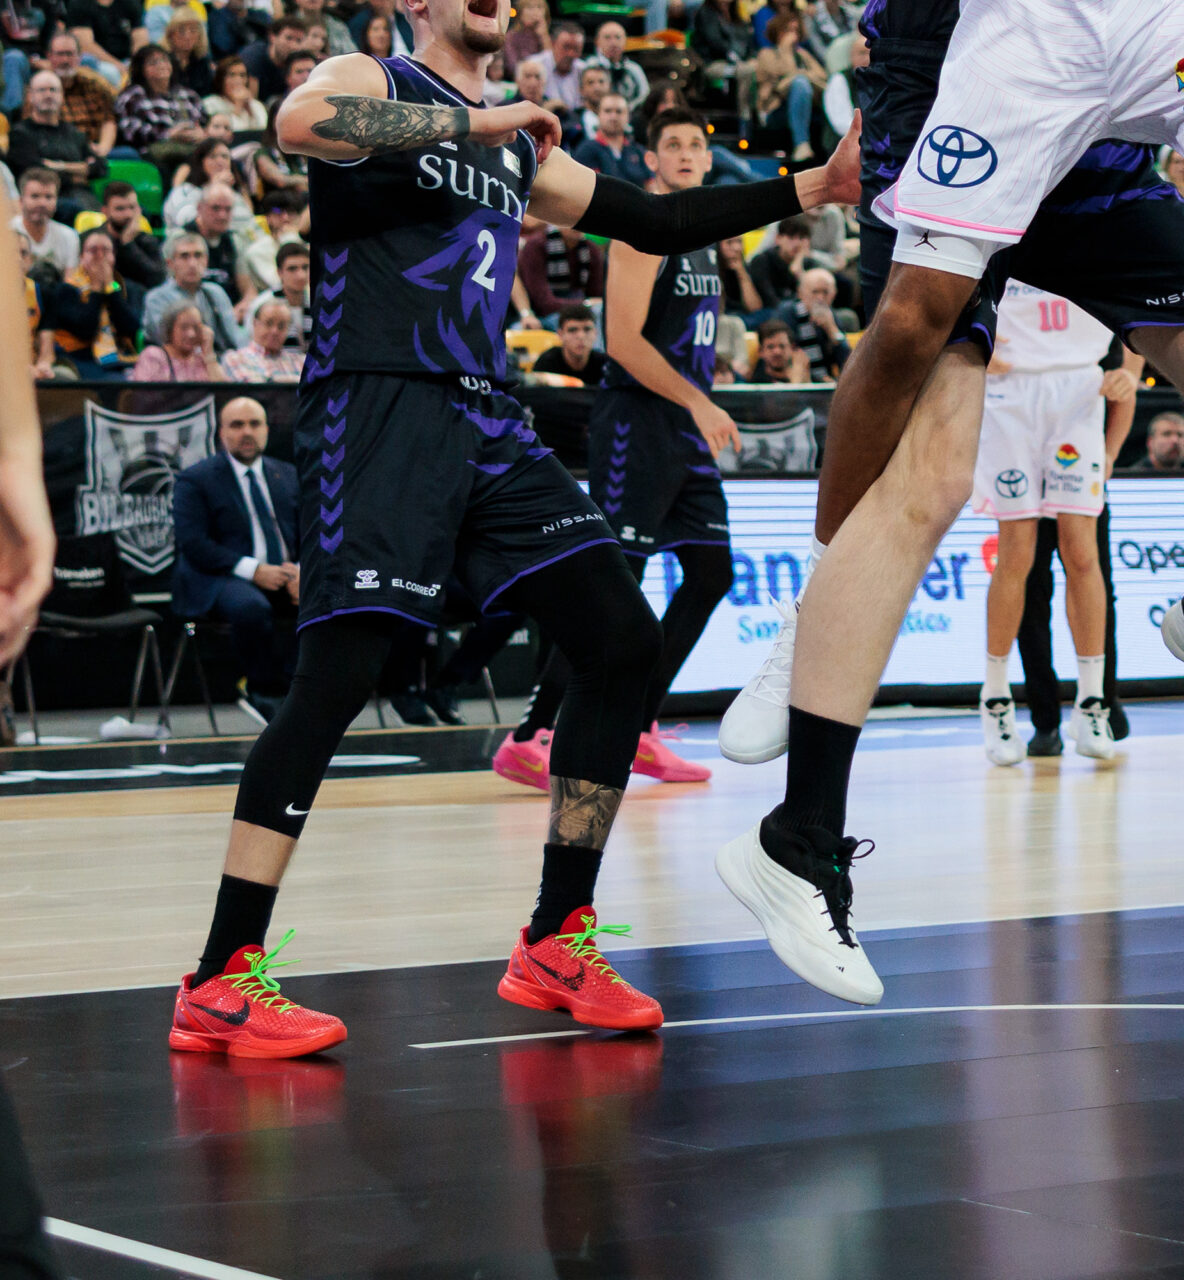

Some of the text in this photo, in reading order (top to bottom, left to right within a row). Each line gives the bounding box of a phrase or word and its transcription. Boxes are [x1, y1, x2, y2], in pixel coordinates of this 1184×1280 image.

[417, 154, 529, 224] surn
[471, 229, 497, 292] 2
[674, 273, 721, 296] surn
[694, 310, 716, 346] 10
[1038, 300, 1068, 332] 10
[542, 513, 603, 533] NISSAN
[392, 578, 405, 588] EL
[405, 581, 437, 597] CORREO
